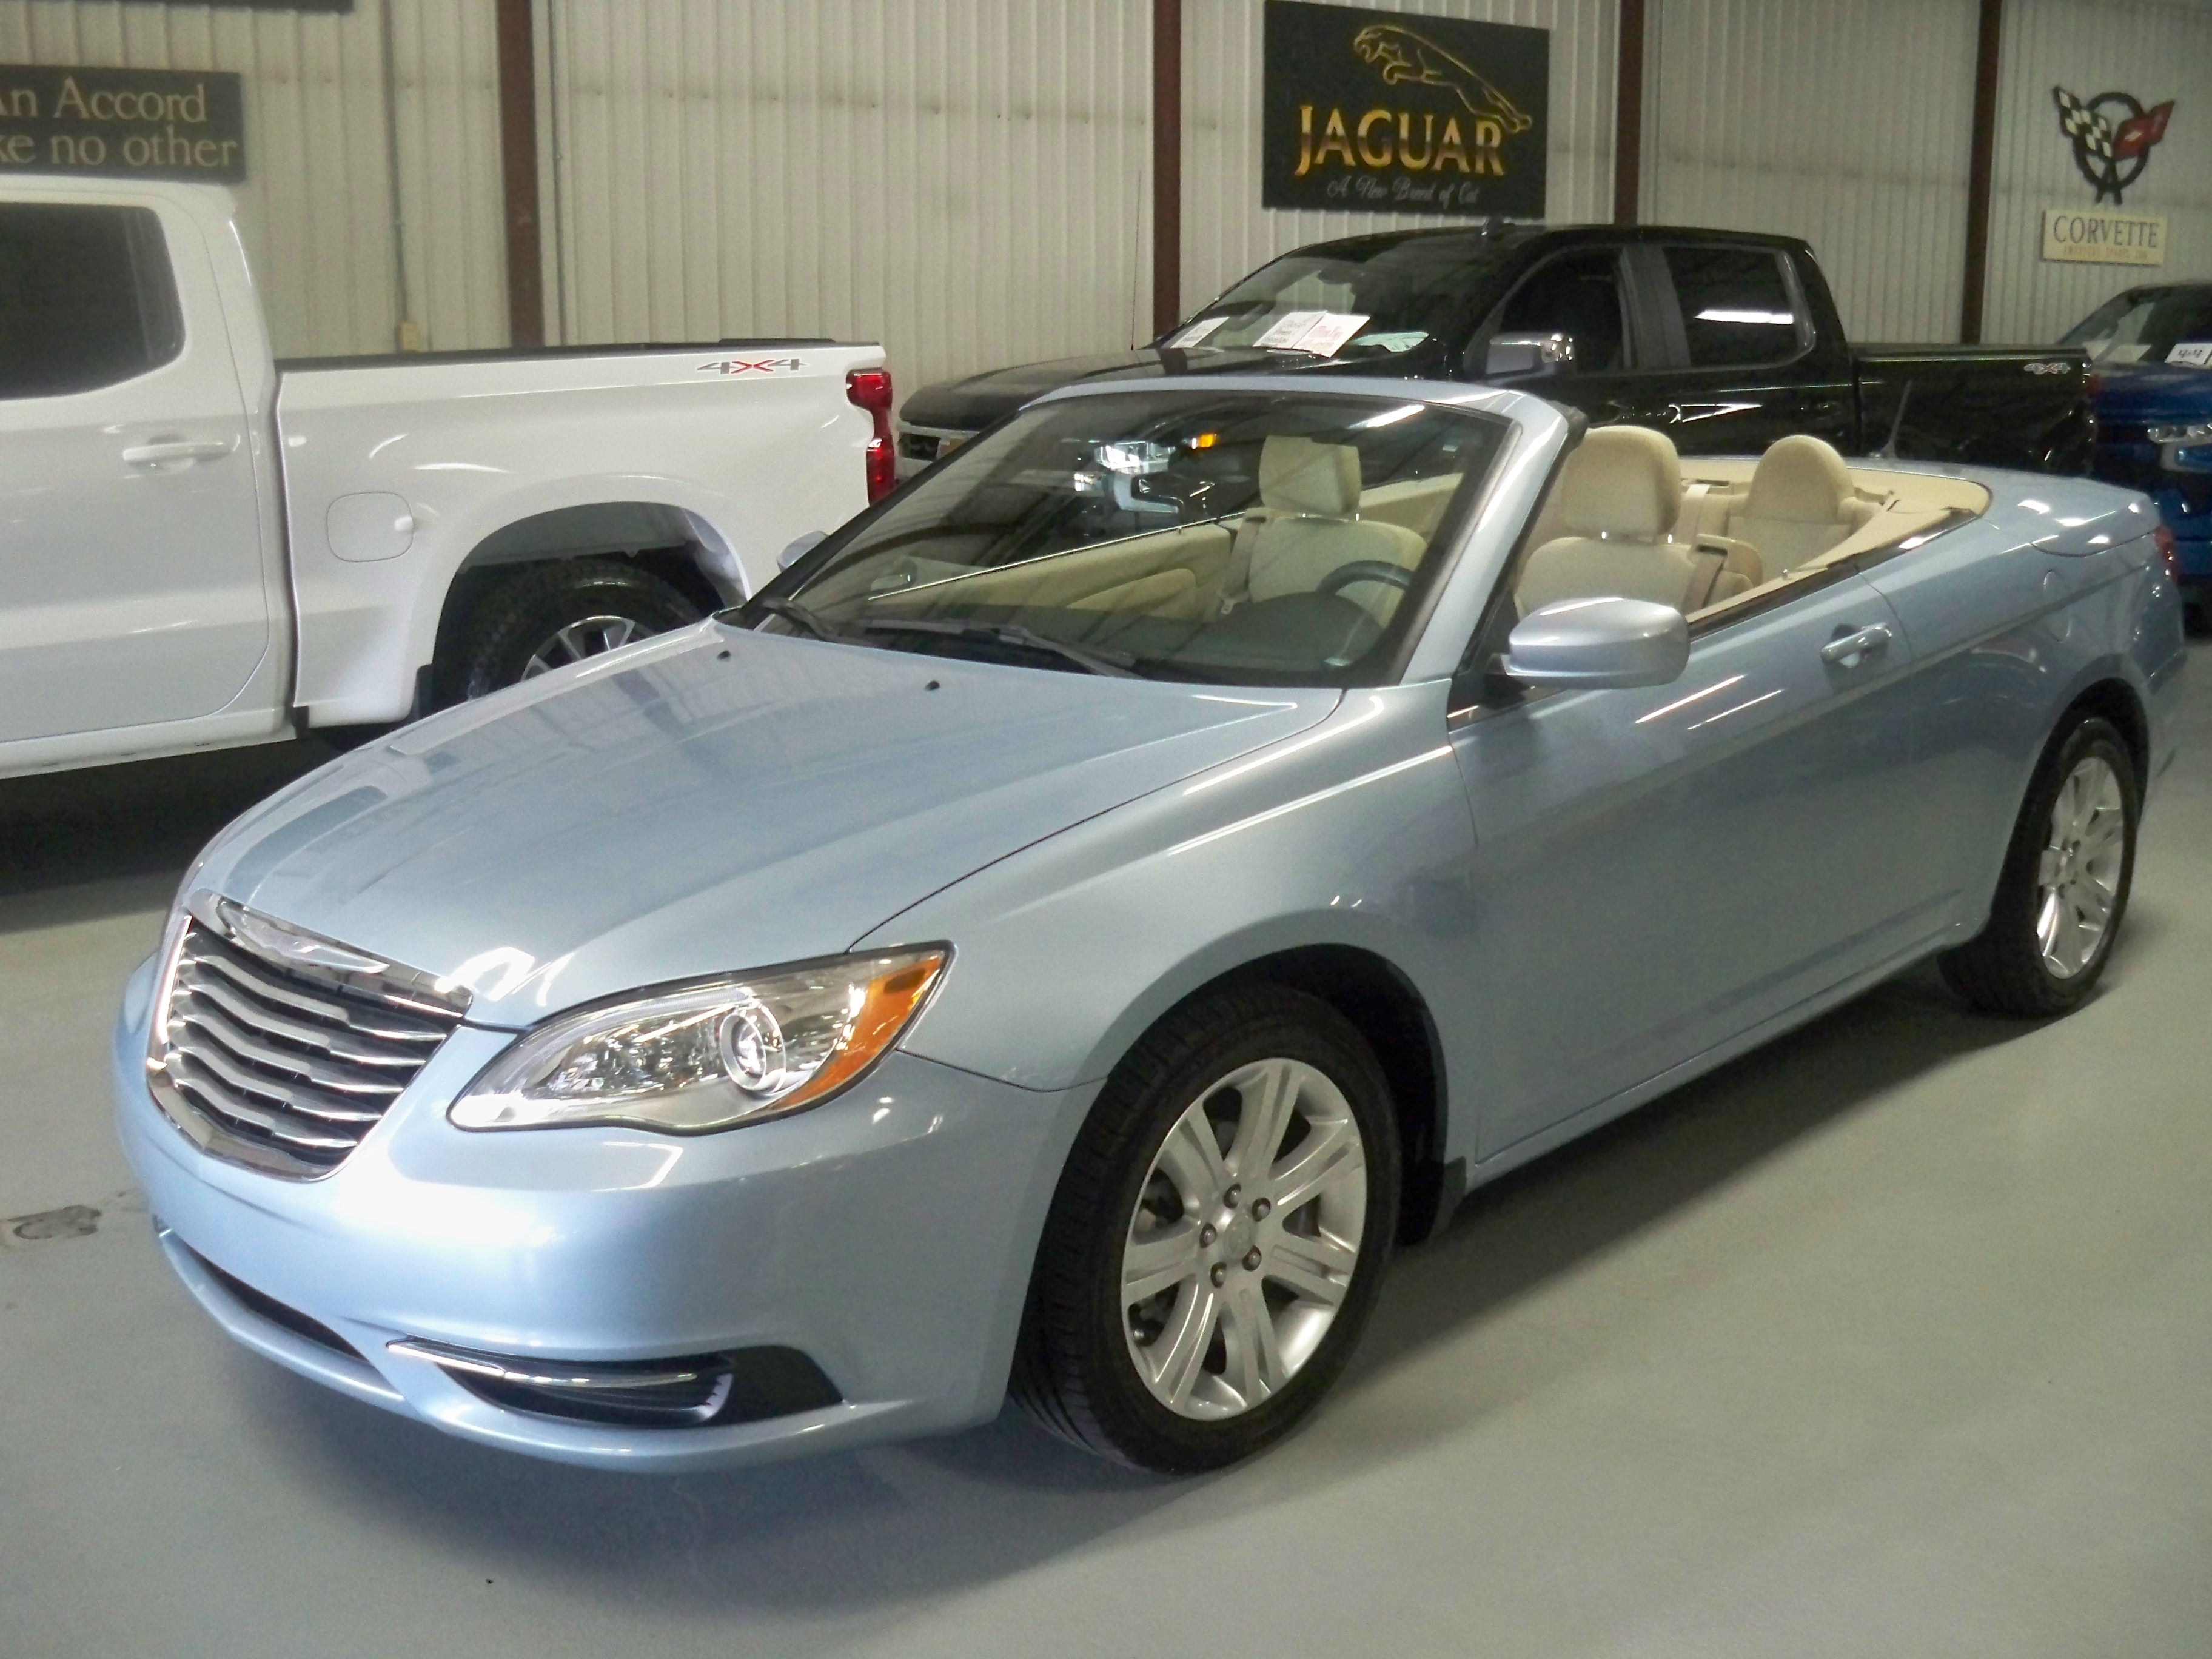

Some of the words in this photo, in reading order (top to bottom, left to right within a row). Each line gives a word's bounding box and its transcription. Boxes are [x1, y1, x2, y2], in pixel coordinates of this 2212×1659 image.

[0, 89, 38, 117] n
[53, 76, 207, 123] Accord
[51, 135, 106, 166] no
[123, 123, 238, 167] other
[1295, 105, 1504, 176] JAGUAR
[2053, 215, 2159, 247] CORVETTE
